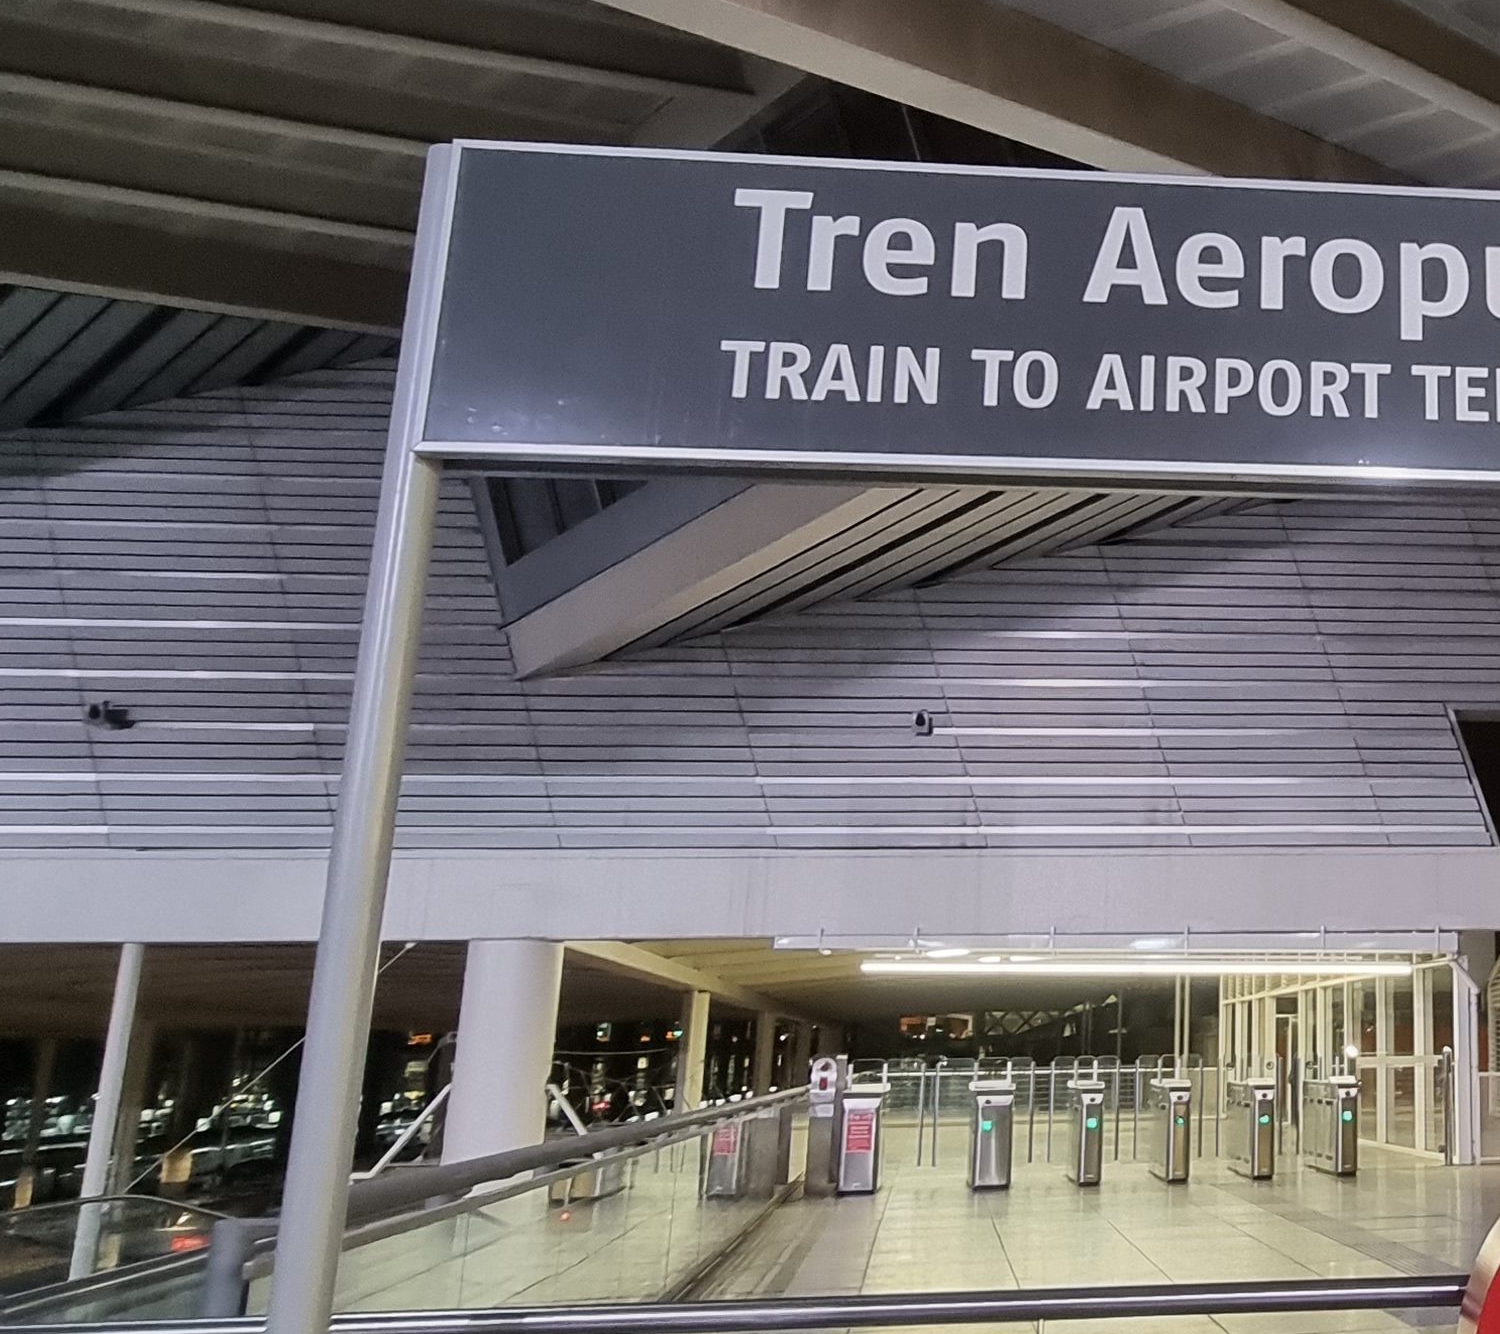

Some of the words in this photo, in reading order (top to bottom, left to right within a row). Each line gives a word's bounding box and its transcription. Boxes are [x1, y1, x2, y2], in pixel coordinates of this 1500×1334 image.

[735, 189, 1027, 299] Tren
[721, 340, 939, 404] TRAIN
[971, 349, 1058, 408] TO
[1086, 354, 1391, 418] AIRPORT
